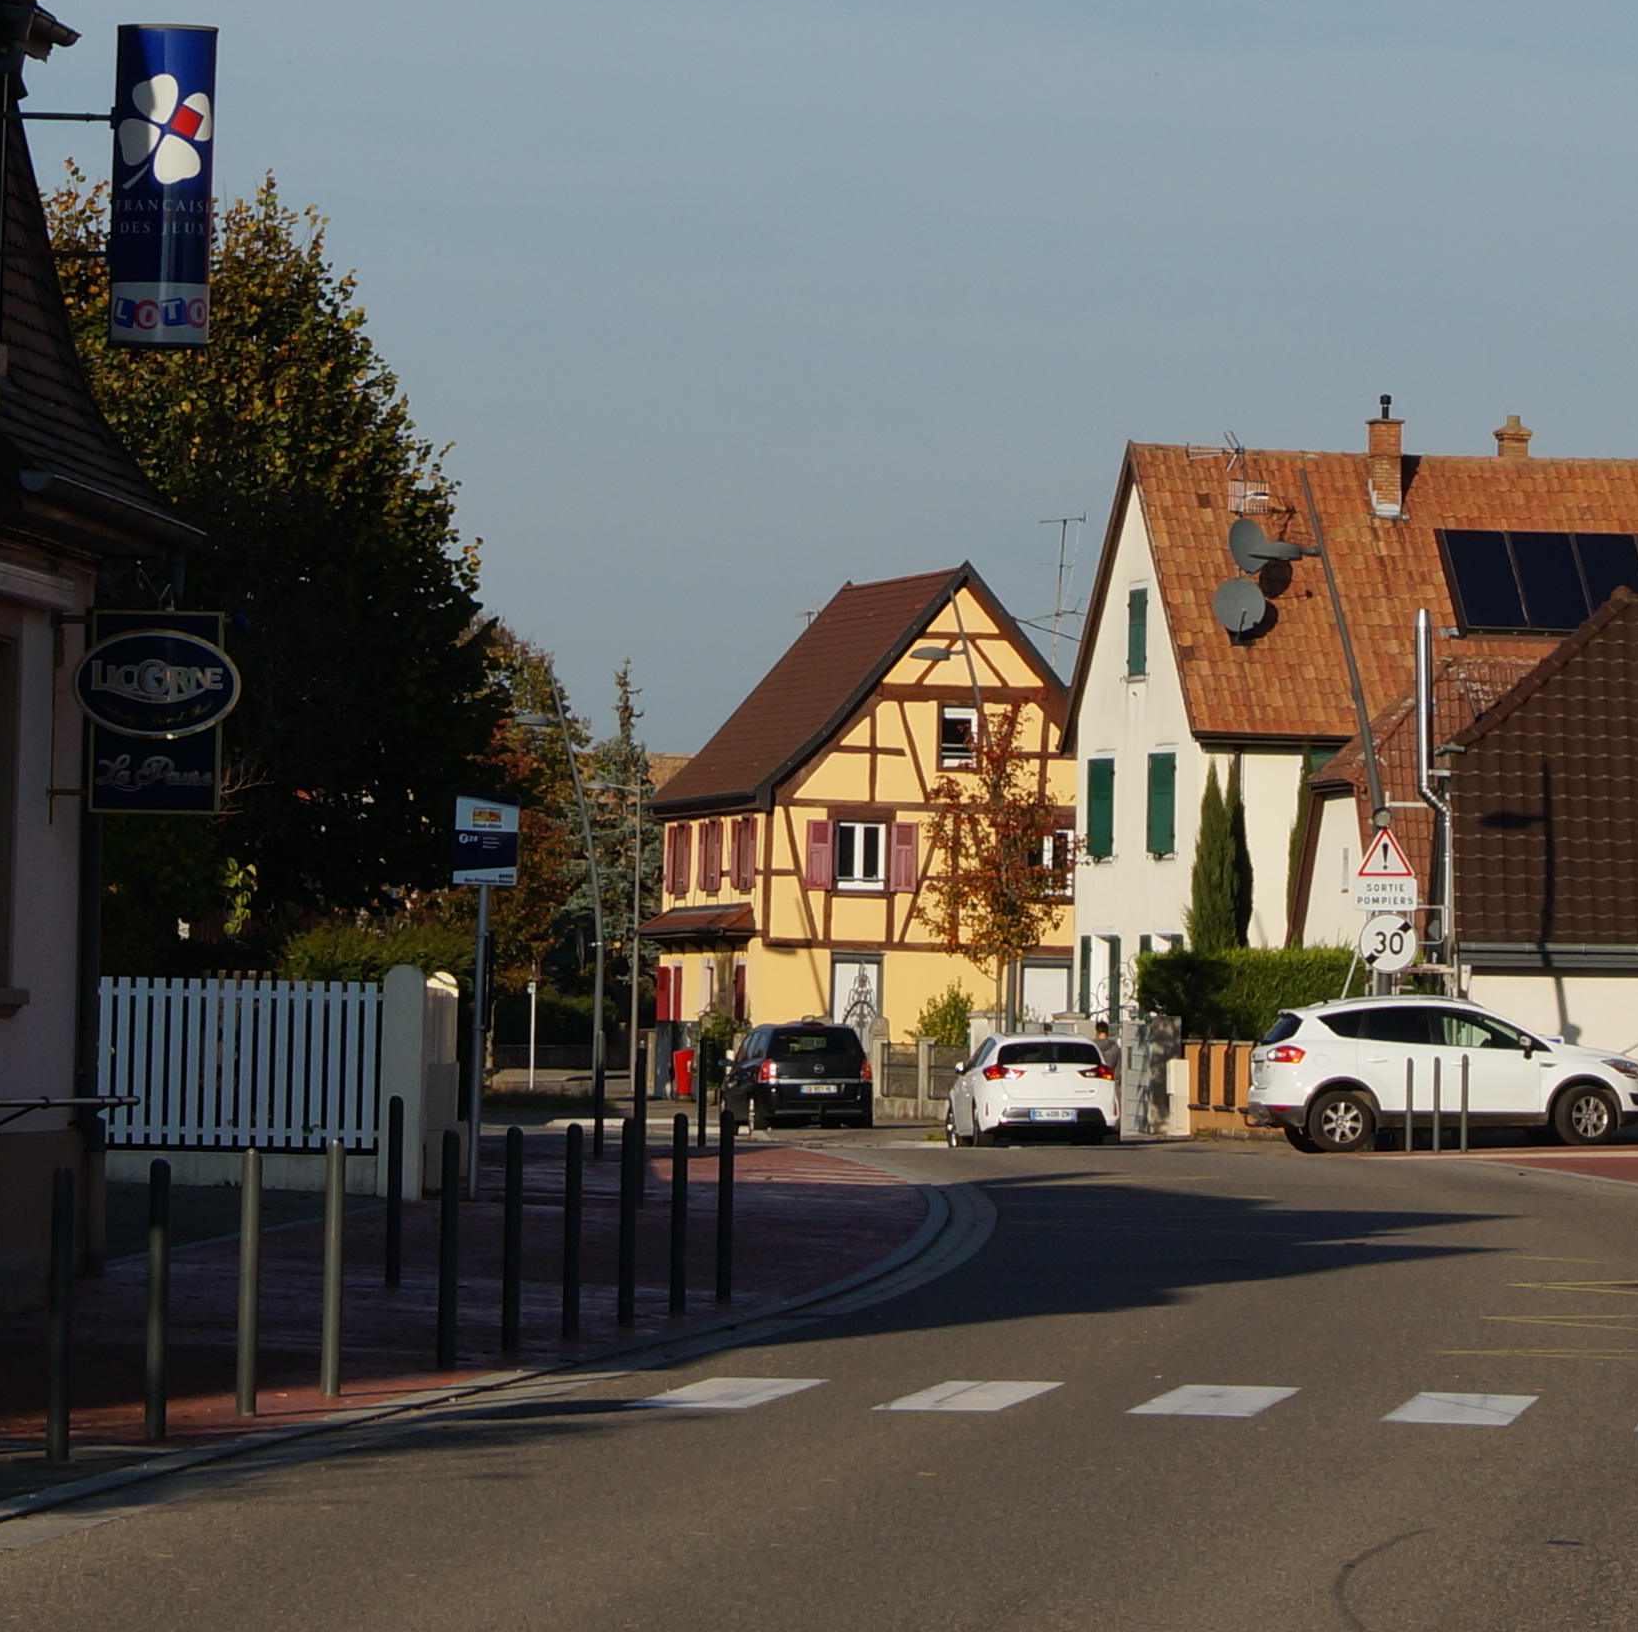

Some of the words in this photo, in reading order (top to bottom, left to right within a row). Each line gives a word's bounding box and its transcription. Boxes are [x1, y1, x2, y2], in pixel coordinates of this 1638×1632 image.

[120, 220, 151, 234] DES
[161, 221, 206, 236] JEUX
[115, 299, 208, 328] LOTO
[90, 658, 224, 703] LICORNE
[95, 753, 137, 792] La
[1366, 883, 1405, 892] SORTIE
[1357, 896, 1414, 905] POMPIERS
[1373, 931, 1404, 955] 30
